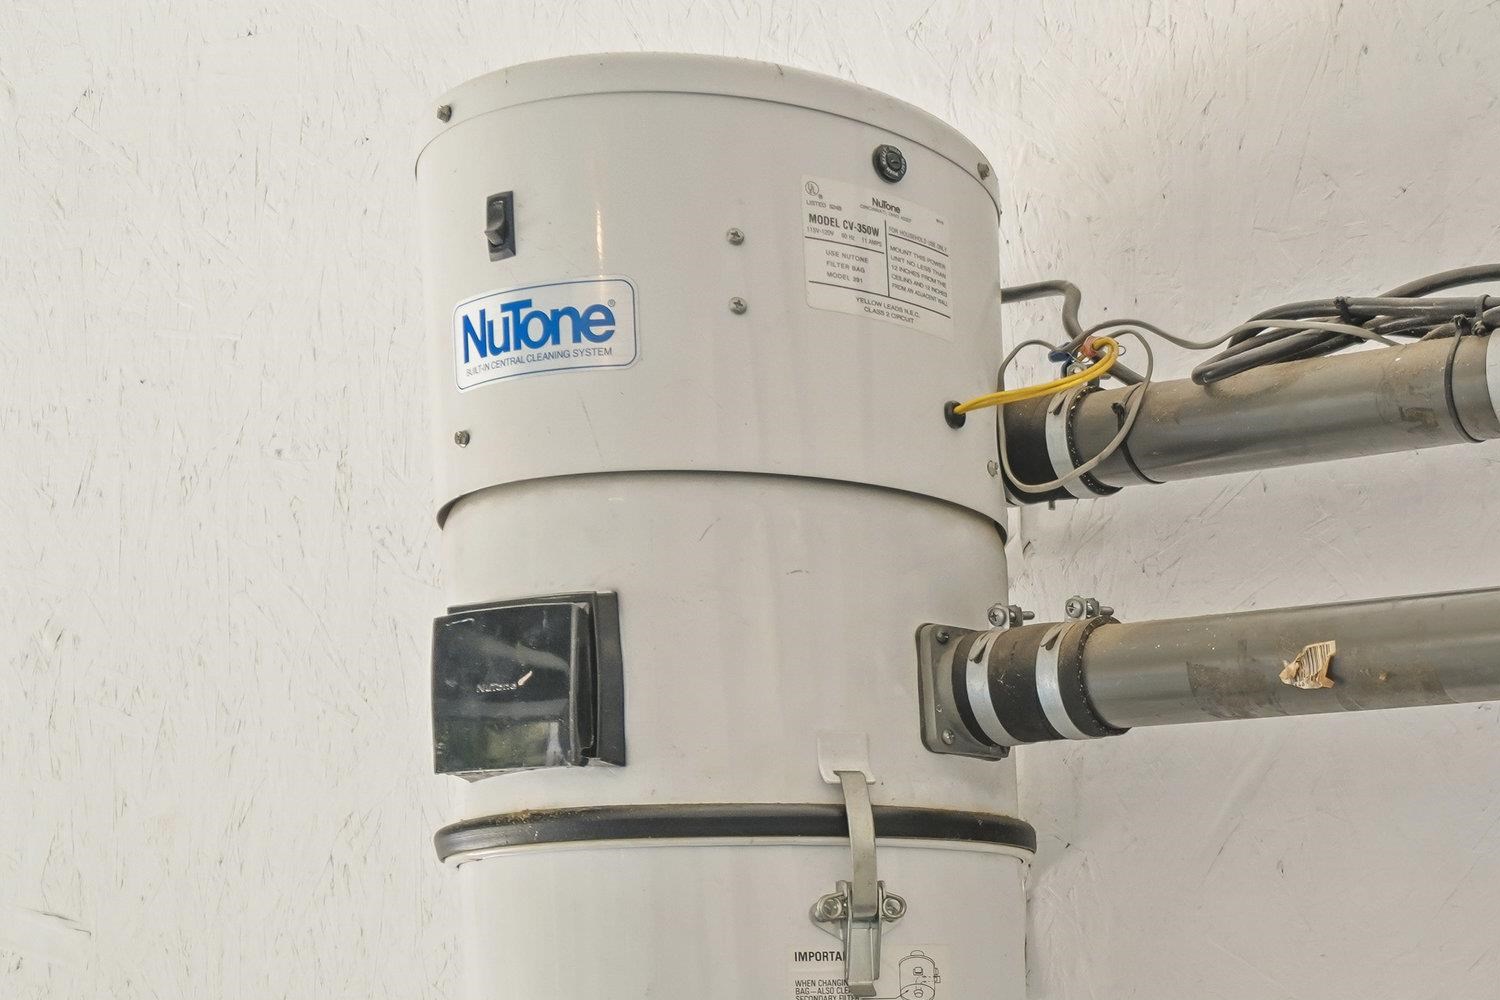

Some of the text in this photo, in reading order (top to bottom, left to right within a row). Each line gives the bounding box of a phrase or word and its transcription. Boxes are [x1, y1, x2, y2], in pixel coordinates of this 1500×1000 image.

[871, 197, 900, 214] NuTone
[808, 213, 880, 237] MODEL CV-350W
[825, 249, 869, 264] USE NUTONE
[890, 245, 946, 270] MOUNT THIS POWER
[826, 260, 866, 274] FILTER BAG
[890, 254, 947, 279] UNIT NO LESS THAN
[826, 271, 850, 281] MODEL
[891, 273, 912, 285] CEILING
[913, 280, 924, 289] AND
[899, 266, 920, 278] INCHES
[921, 273, 936, 283] FROM
[937, 279, 947, 289] THE
[892, 283, 907, 291] FROM
[856, 296, 921, 319] YELLOW LEADS N.E.C.
[863, 306, 886, 317] CLASS
[891, 312, 915, 324] CIRCUIT
[462, 298, 616, 364] NuTone
[491, 356, 526, 370] CENTRAL
[526, 349, 571, 364] CLEANING
[572, 347, 613, 358] SYSTEM
[794, 951, 846, 962] IMPORTA
[795, 979, 849, 987] WHEN CHANGIN
